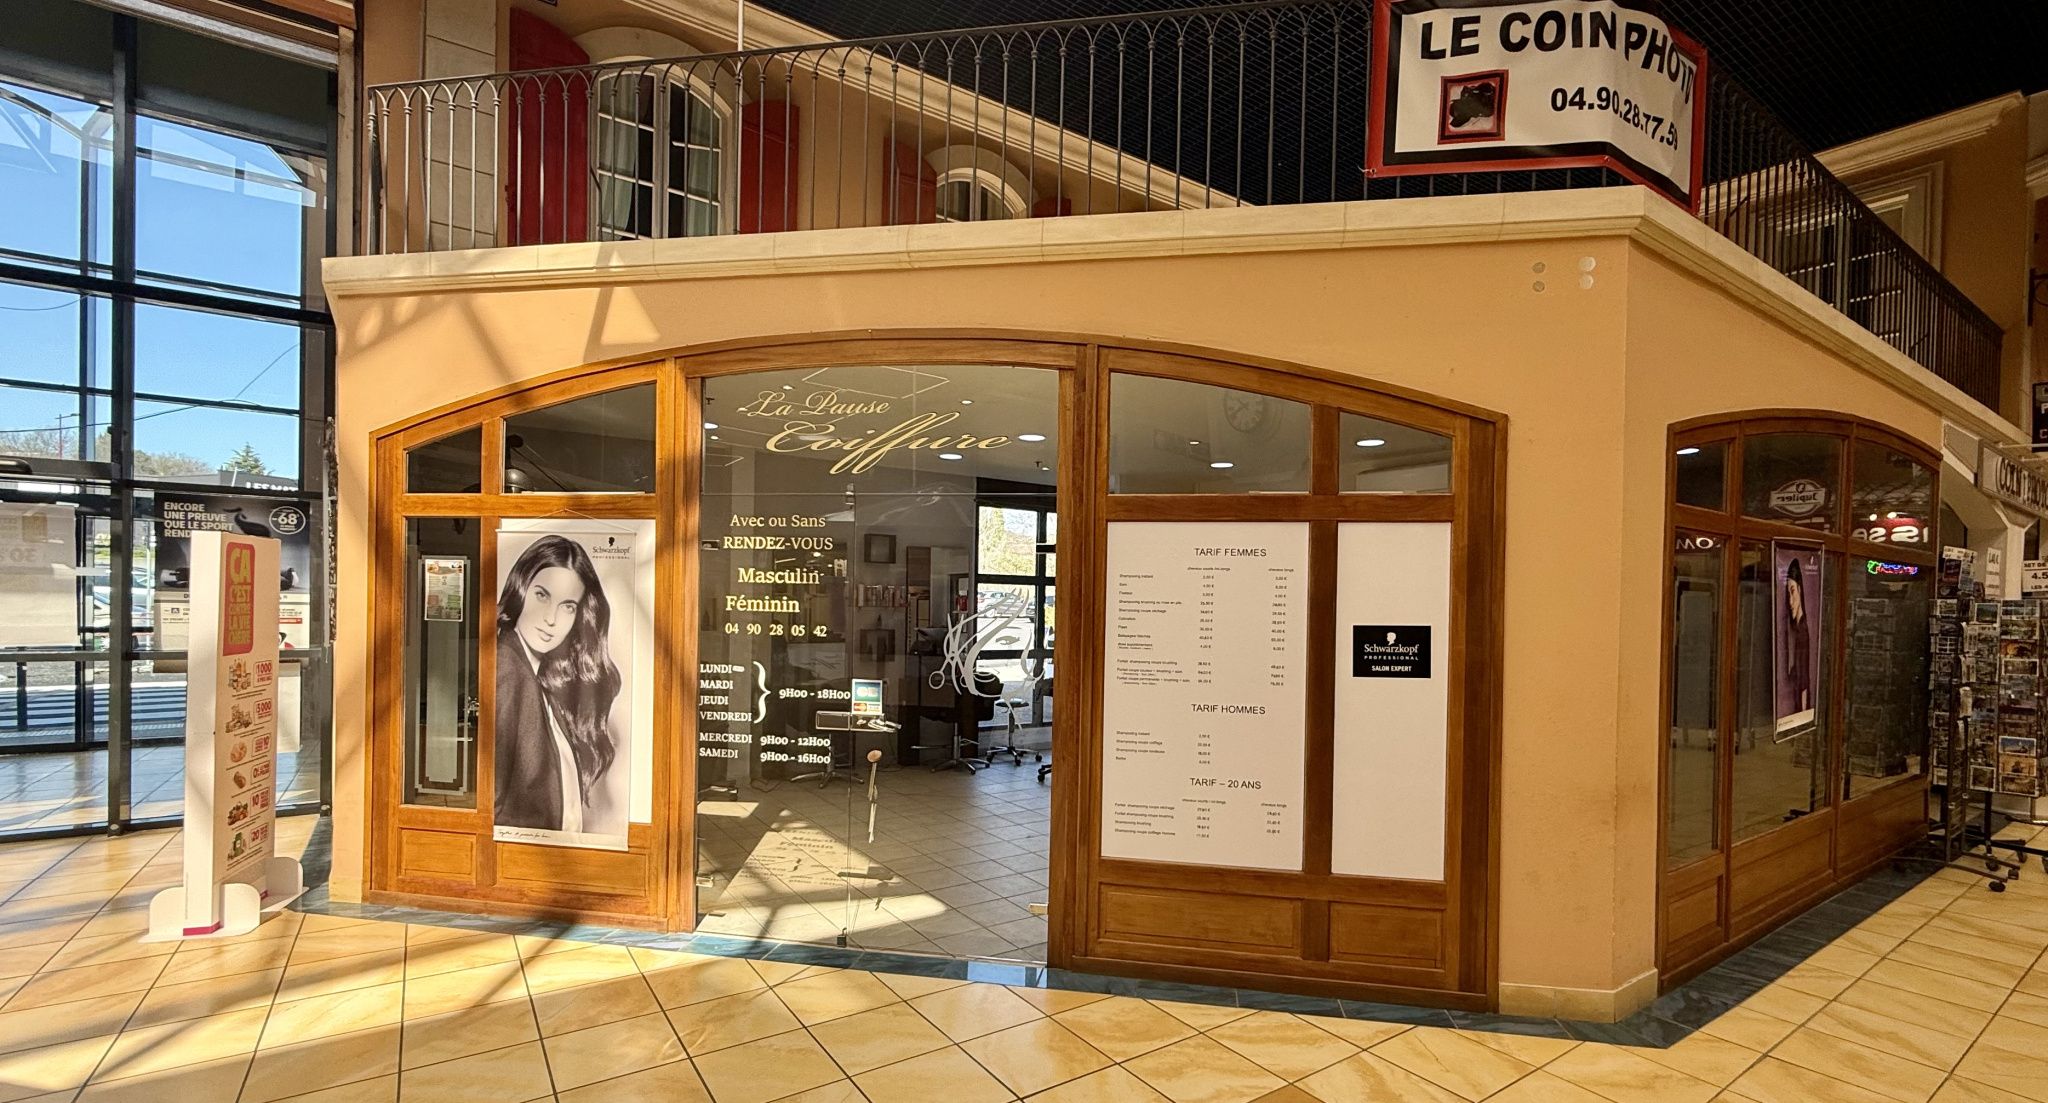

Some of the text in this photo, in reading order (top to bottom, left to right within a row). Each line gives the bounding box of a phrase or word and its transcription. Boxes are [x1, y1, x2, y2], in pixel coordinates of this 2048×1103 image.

[1420, 15, 1481, 60] LE
[1499, 10, 1617, 53] COIN
[737, 390, 891, 417] La Pause
[765, 411, 1012, 475] Coiffure
[164, 501, 205, 512] ENCORE
[164, 511, 227, 522] UNE PREUVE
[730, 514, 826, 528] Avec ou Sans
[164, 520, 234, 531] QUE LE SPORT
[723, 536, 834, 551] RENDEZ-VOUS
[1195, 548, 1267, 557] TARIF FEMMES
[737, 567, 820, 585] Masculin
[726, 594, 800, 613] Féminin
[725, 623, 828, 638] 04 90 28 05 42
[1364, 643, 1420, 655] Schwarzkopf
[700, 664, 733, 674] LUNDI
[700, 680, 734, 690] MARDI
[779, 688, 808, 699] 9H00
[817, 688, 851, 699] 18H00
[699, 695, 729, 706] JEUDI
[1191, 704, 1266, 715] TARIF HOMMES
[700, 711, 752, 722] VENDREDI
[700, 733, 752, 744] MERCREDI
[760, 735, 788, 745] 9H00
[797, 736, 831, 747] 12H00
[699, 748, 739, 759] SAMEDI
[760, 752, 788, 762] 9H00
[797, 752, 831, 764] 16H00
[1190, 778, 1217, 787] TARIF
[1227, 779, 1239, 789] 20
[1241, 779, 1262, 790] ANS
